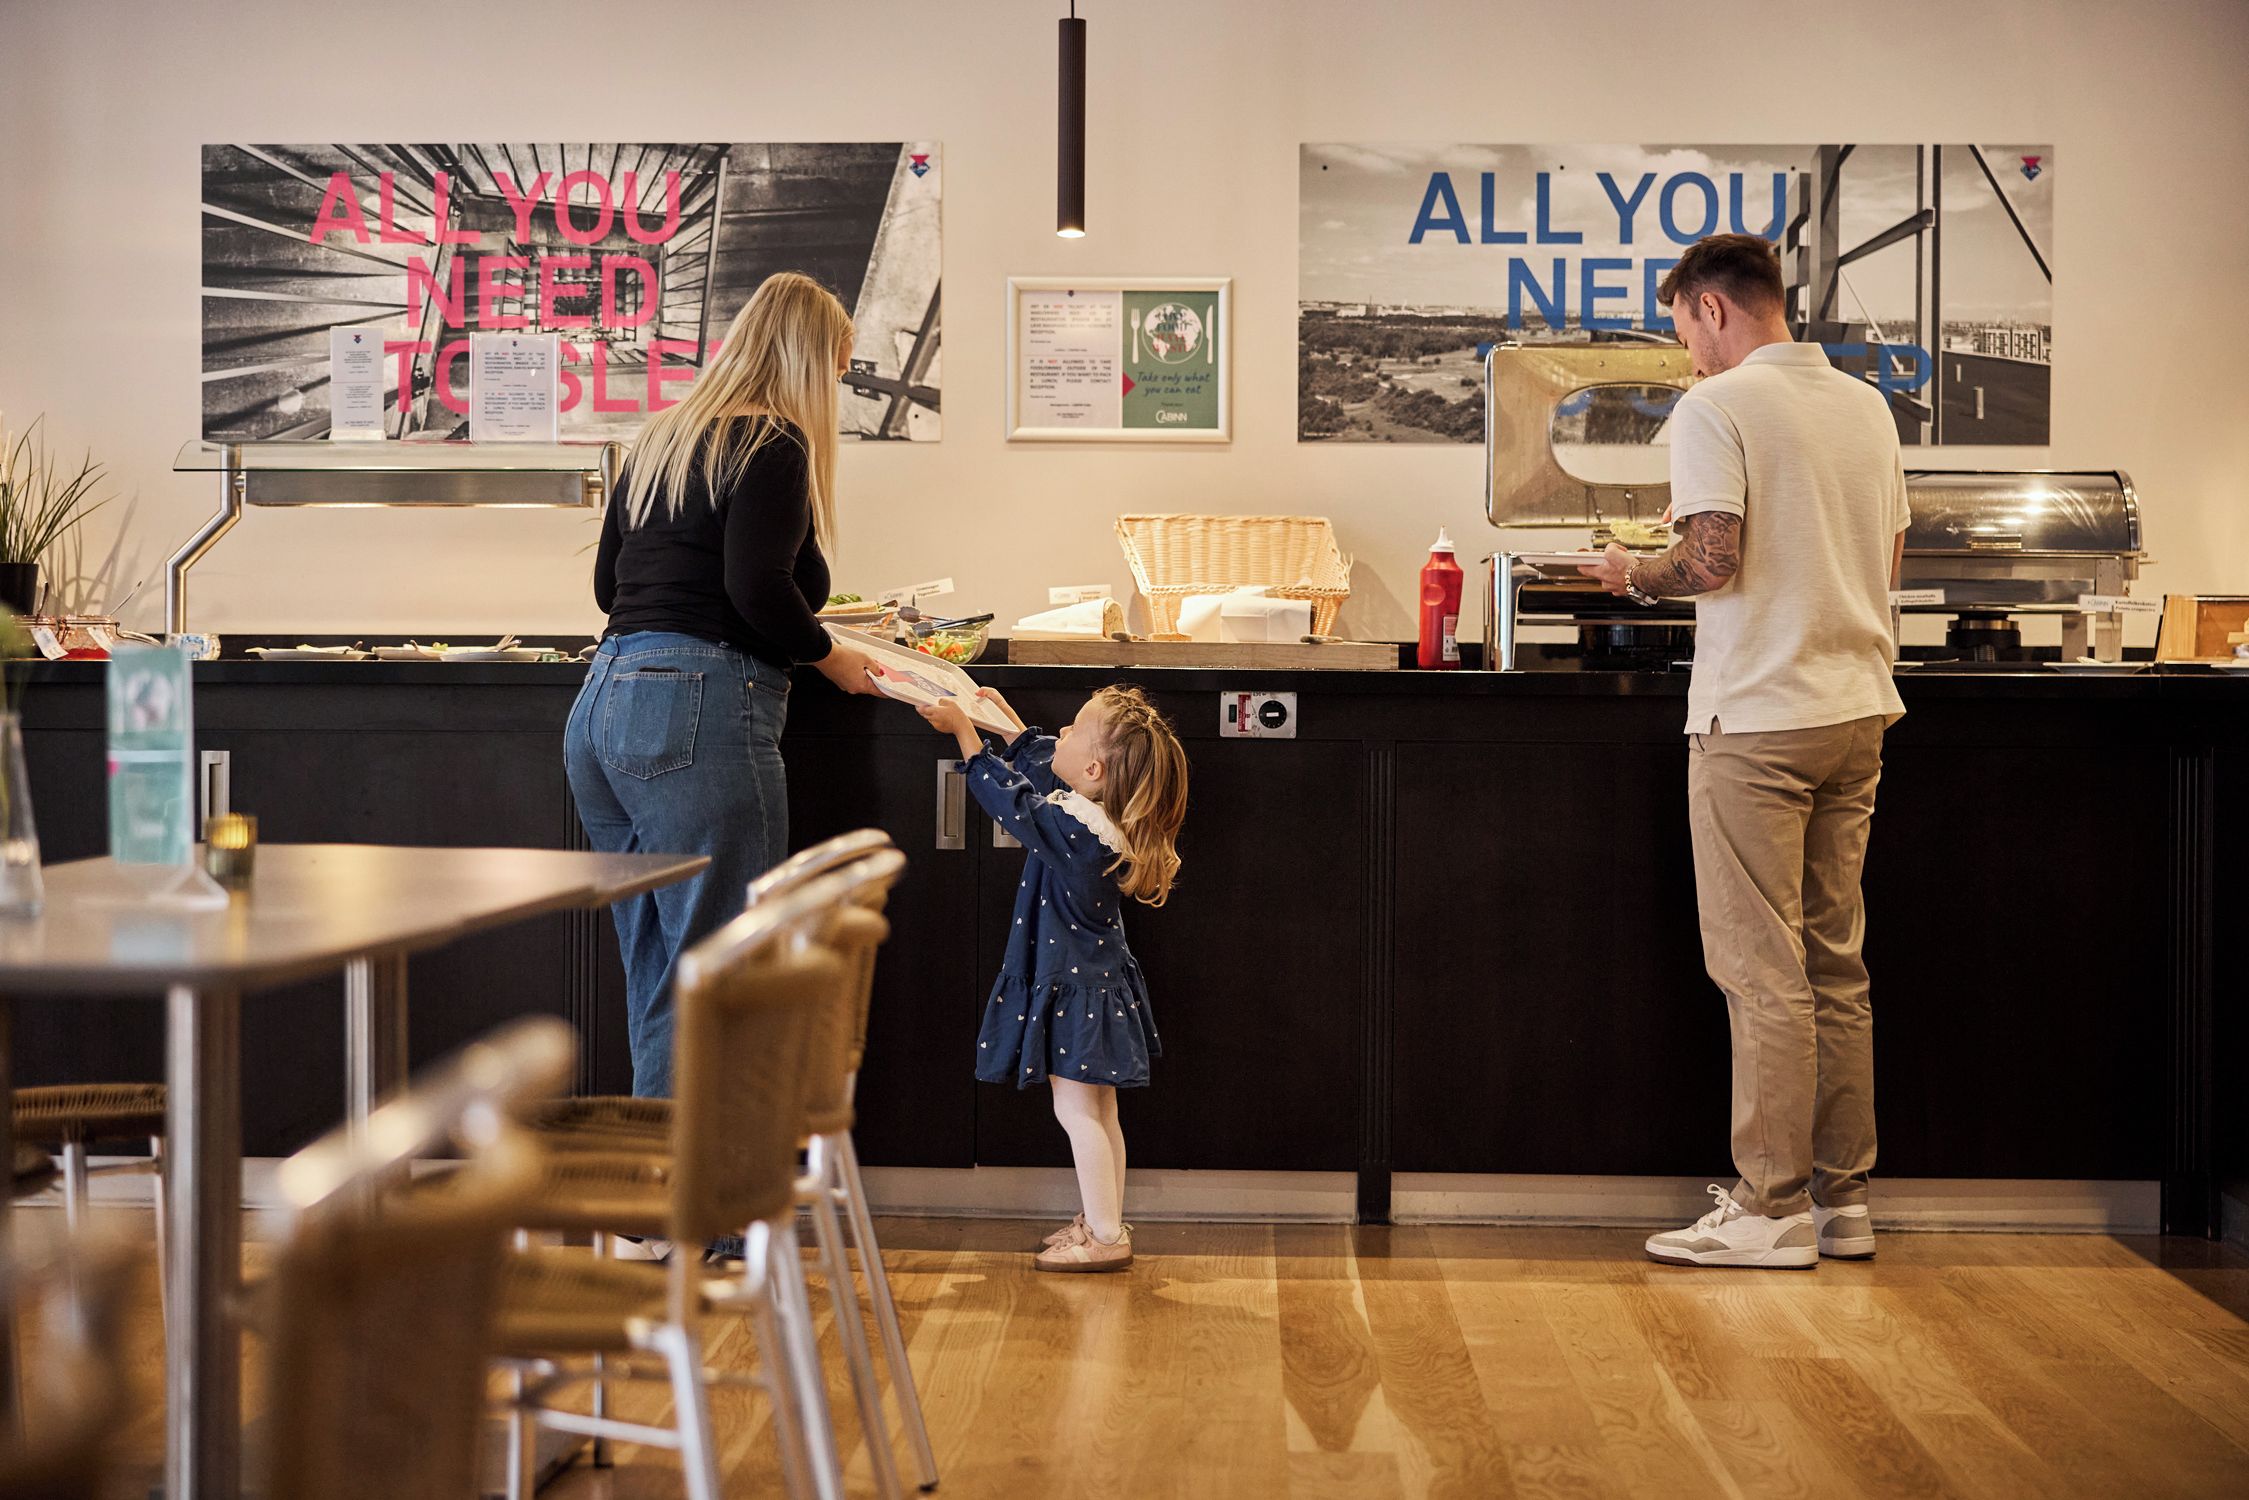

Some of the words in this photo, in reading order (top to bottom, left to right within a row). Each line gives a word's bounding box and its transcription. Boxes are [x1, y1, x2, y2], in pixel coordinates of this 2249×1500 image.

[309, 171, 481, 245] ALL
[492, 170, 681, 245] YOU
[1408, 172, 1583, 245] ALL
[1596, 171, 1787, 246] YOU
[407, 256, 660, 328] NEED
[1508, 257, 1684, 330] NEE
[1137, 371, 1158, 382] Take
[1162, 371, 1181, 385] only
[1184, 371, 1210, 382] what
[1143, 387, 1161, 397] you
[1185, 385, 1201, 394] eat
[1155, 409, 1188, 424] CABINN
